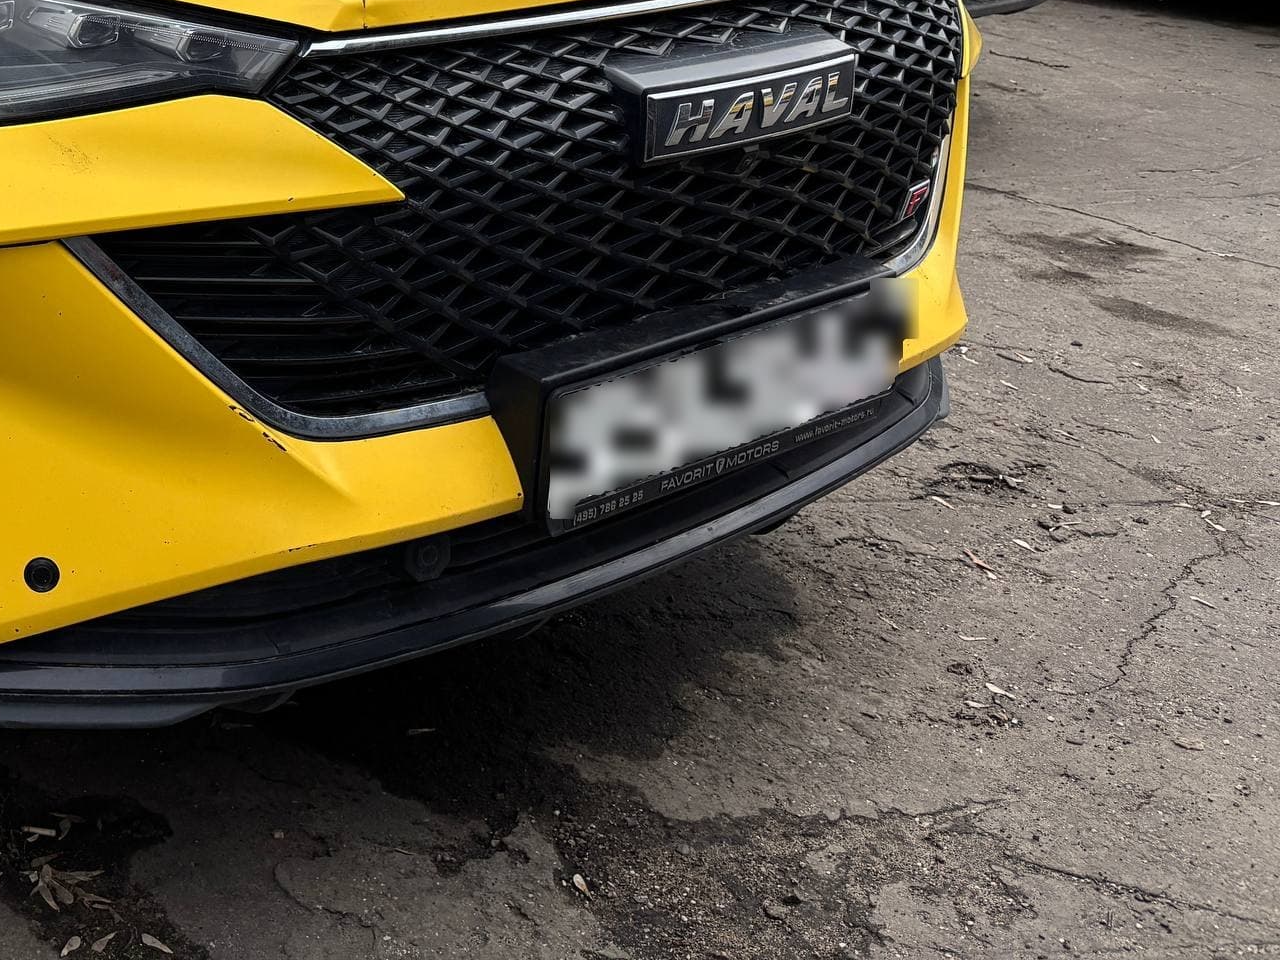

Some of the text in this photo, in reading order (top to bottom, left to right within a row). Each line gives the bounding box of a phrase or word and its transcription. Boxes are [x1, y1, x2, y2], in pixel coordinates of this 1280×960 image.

[664, 72, 850, 147] HAVAL
[632, 490, 644, 502] 25
[660, 463, 714, 491] FAVORIT
[725, 440, 780, 469] MOTORS
